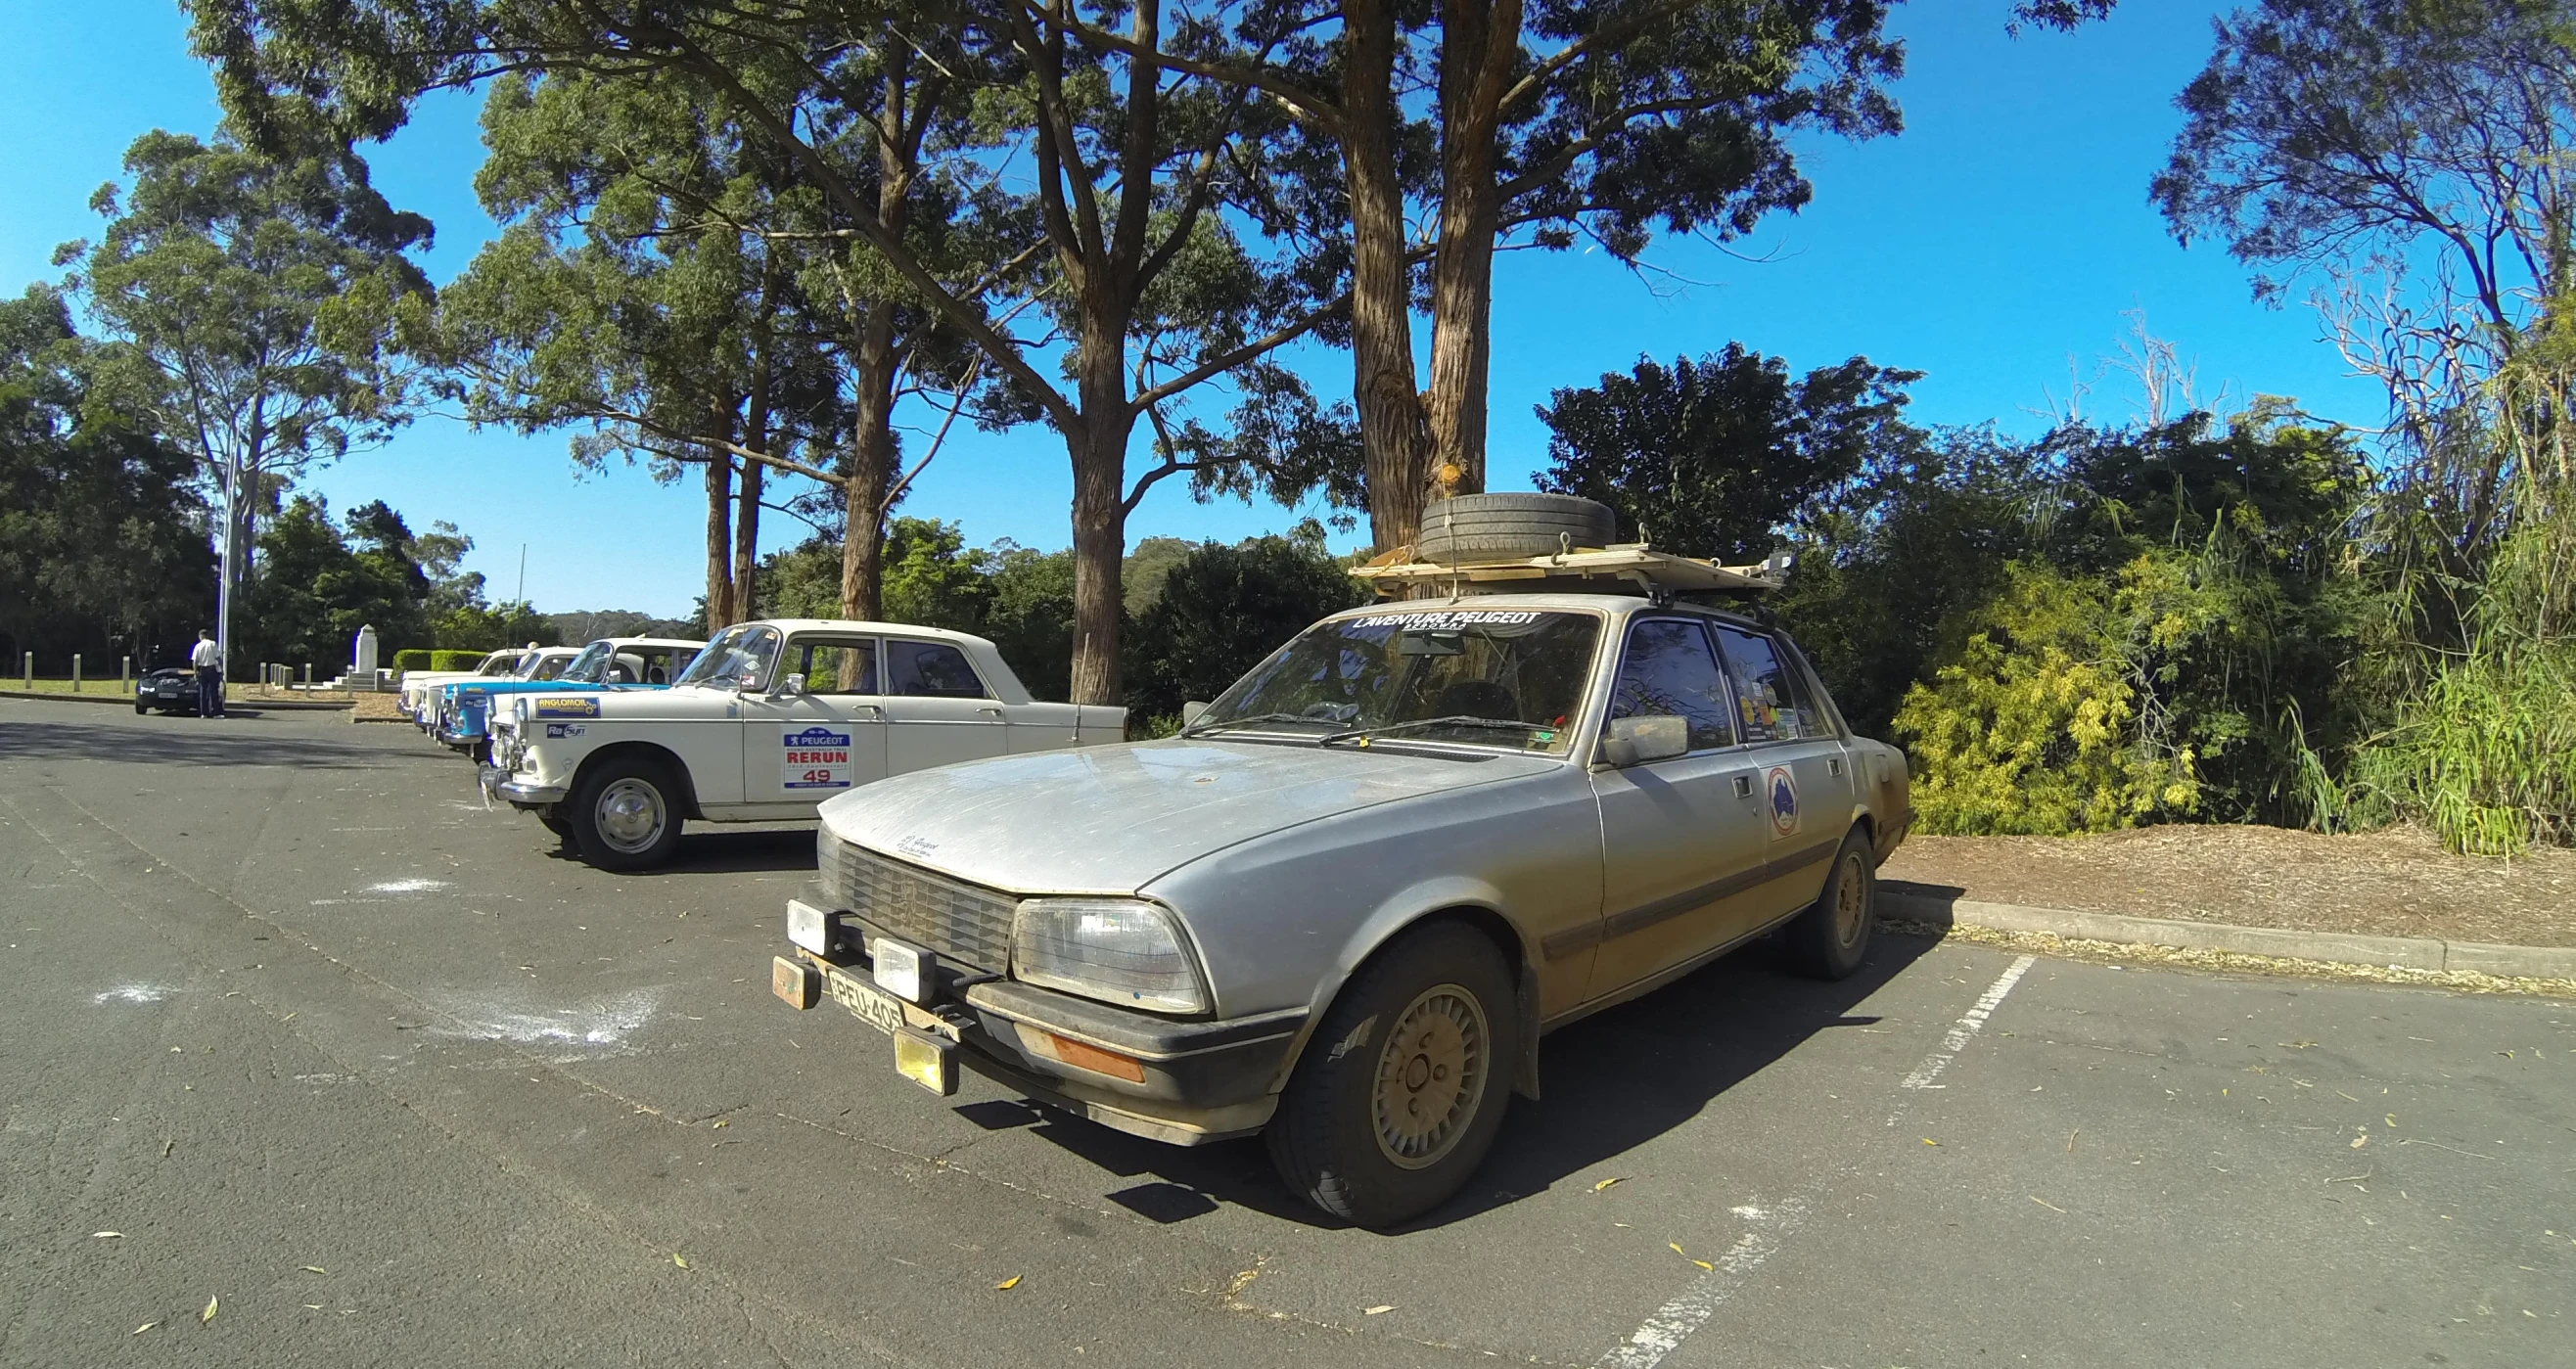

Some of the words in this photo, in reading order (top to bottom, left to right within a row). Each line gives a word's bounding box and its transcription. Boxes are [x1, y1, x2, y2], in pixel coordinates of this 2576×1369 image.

[1353, 612, 1452, 628] L'AVENTURE
[1450, 611, 1541, 624] PEUGEOT
[787, 752, 848, 763] RERUN
[803, 769, 831, 783] 49
